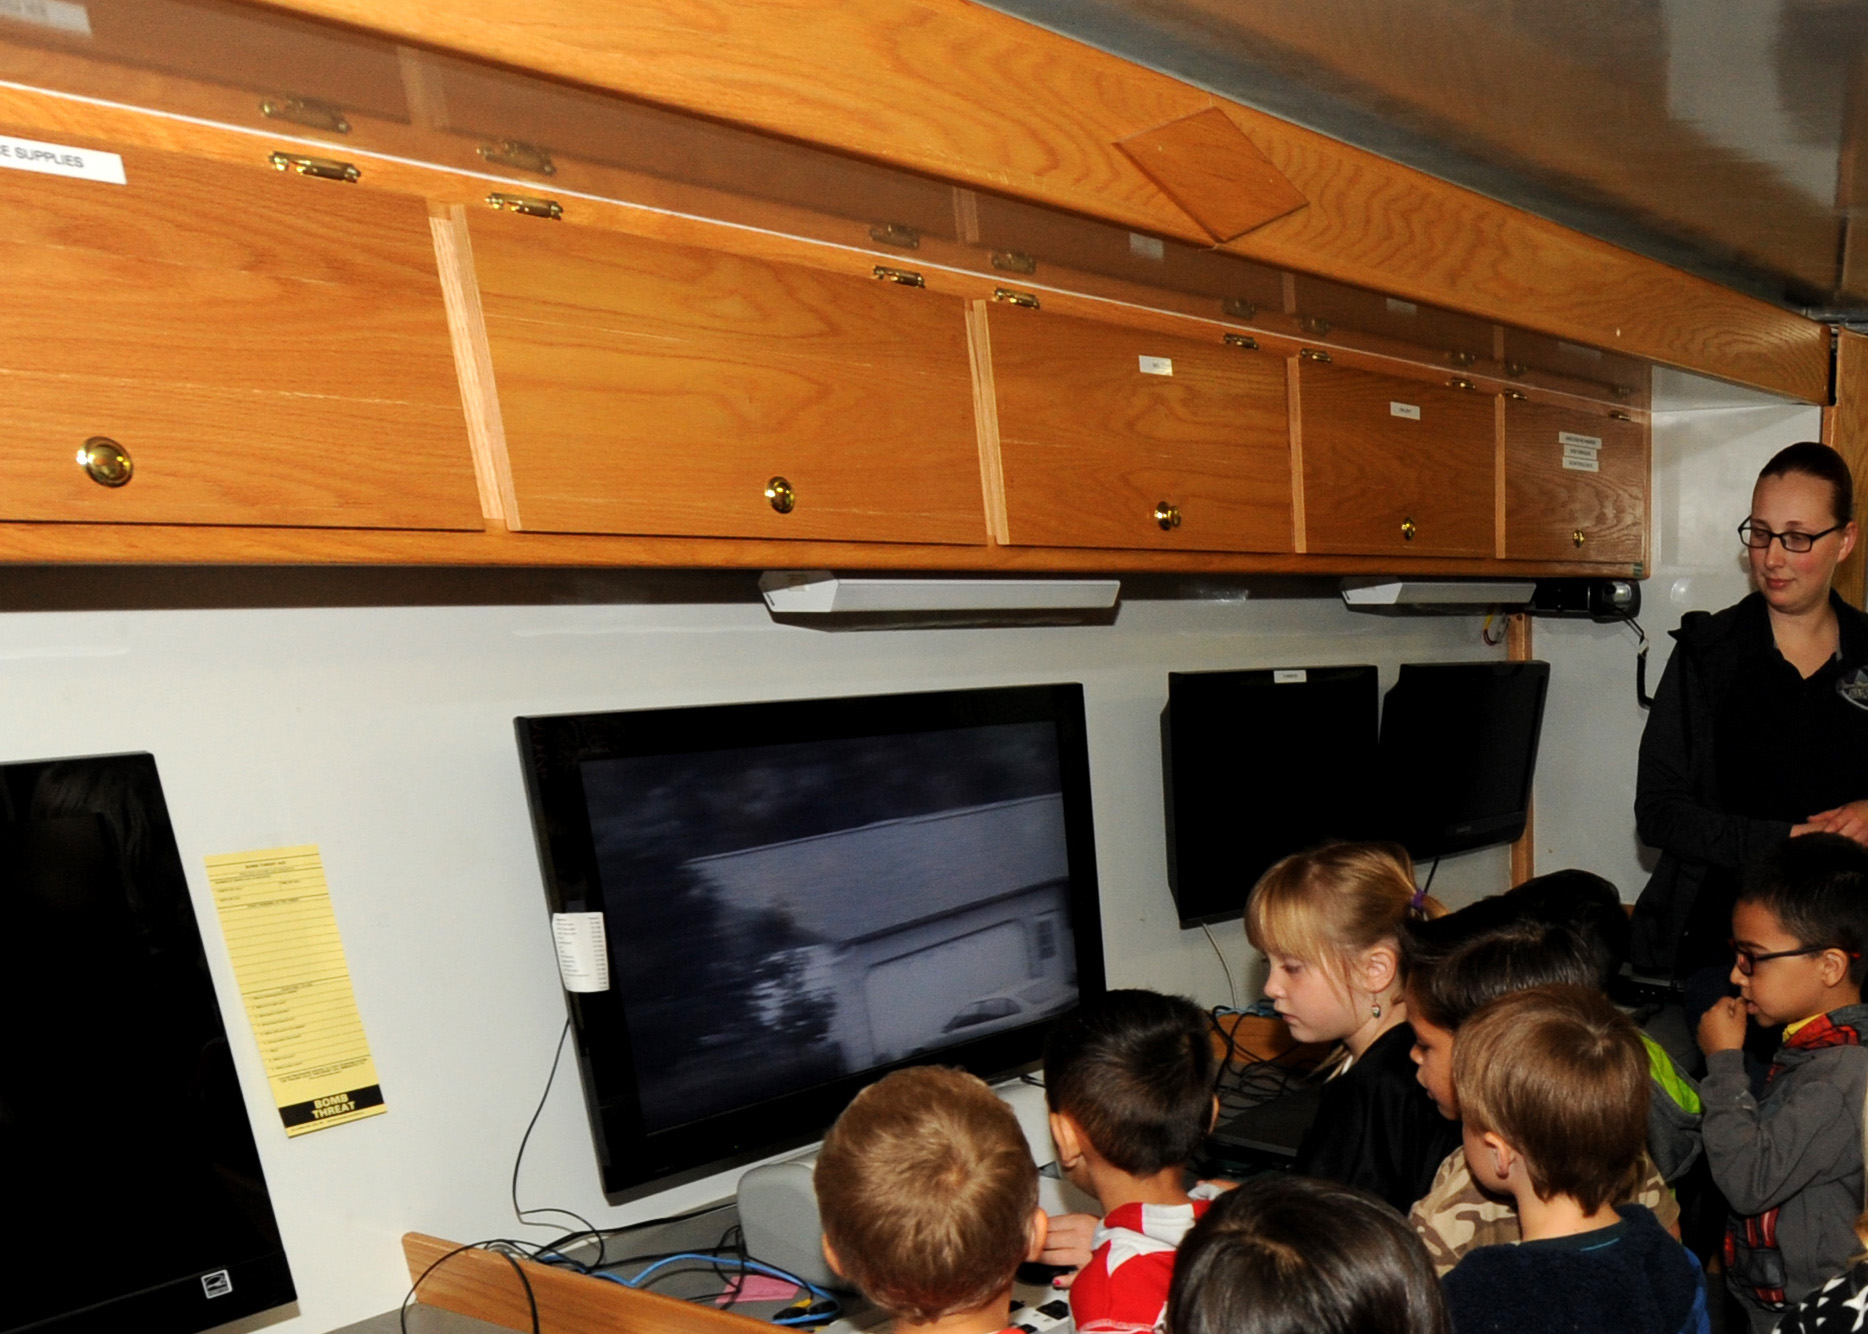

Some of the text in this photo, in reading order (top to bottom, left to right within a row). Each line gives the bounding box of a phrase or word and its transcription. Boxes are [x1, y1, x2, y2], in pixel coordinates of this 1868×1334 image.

[14, 146, 85, 169] SUPPLIES
[311, 1101, 356, 1120] THREAT
[313, 1093, 349, 1110] BOMB
